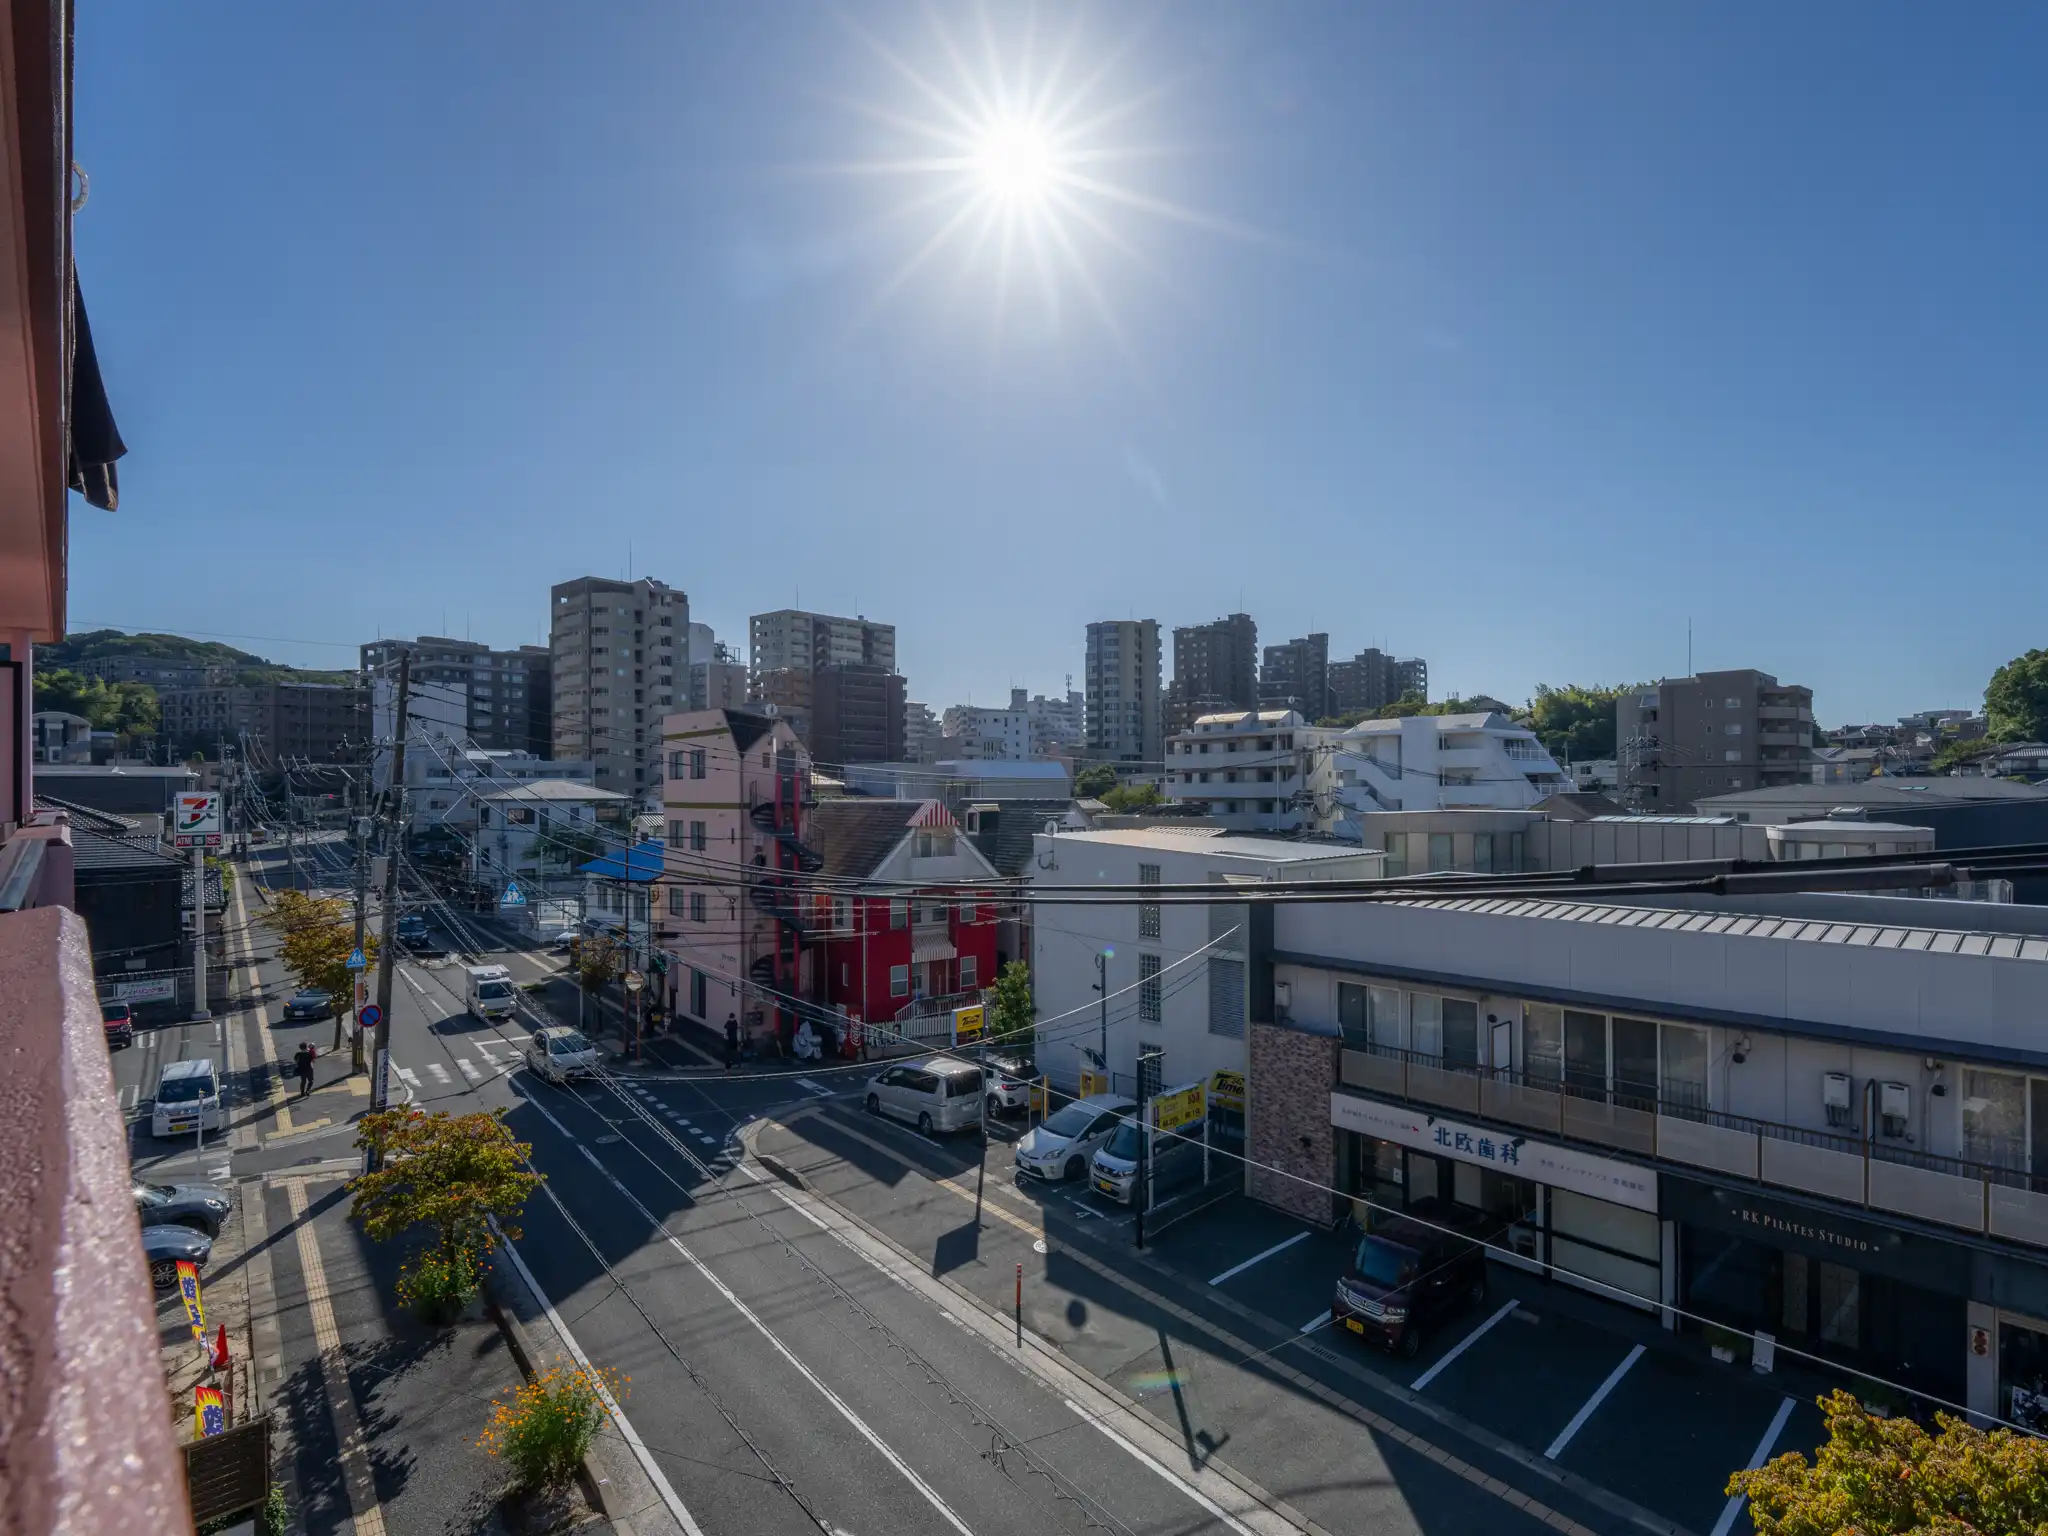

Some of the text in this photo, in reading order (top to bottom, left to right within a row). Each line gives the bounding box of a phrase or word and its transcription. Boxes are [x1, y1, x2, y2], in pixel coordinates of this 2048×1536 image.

[177, 836, 192, 845] ATM
[1215, 1073, 1245, 1098] Time
[1434, 1126, 1520, 1166] 北欧歯科
[1742, 1210, 1868, 1252] RK PILATES STUDIO
